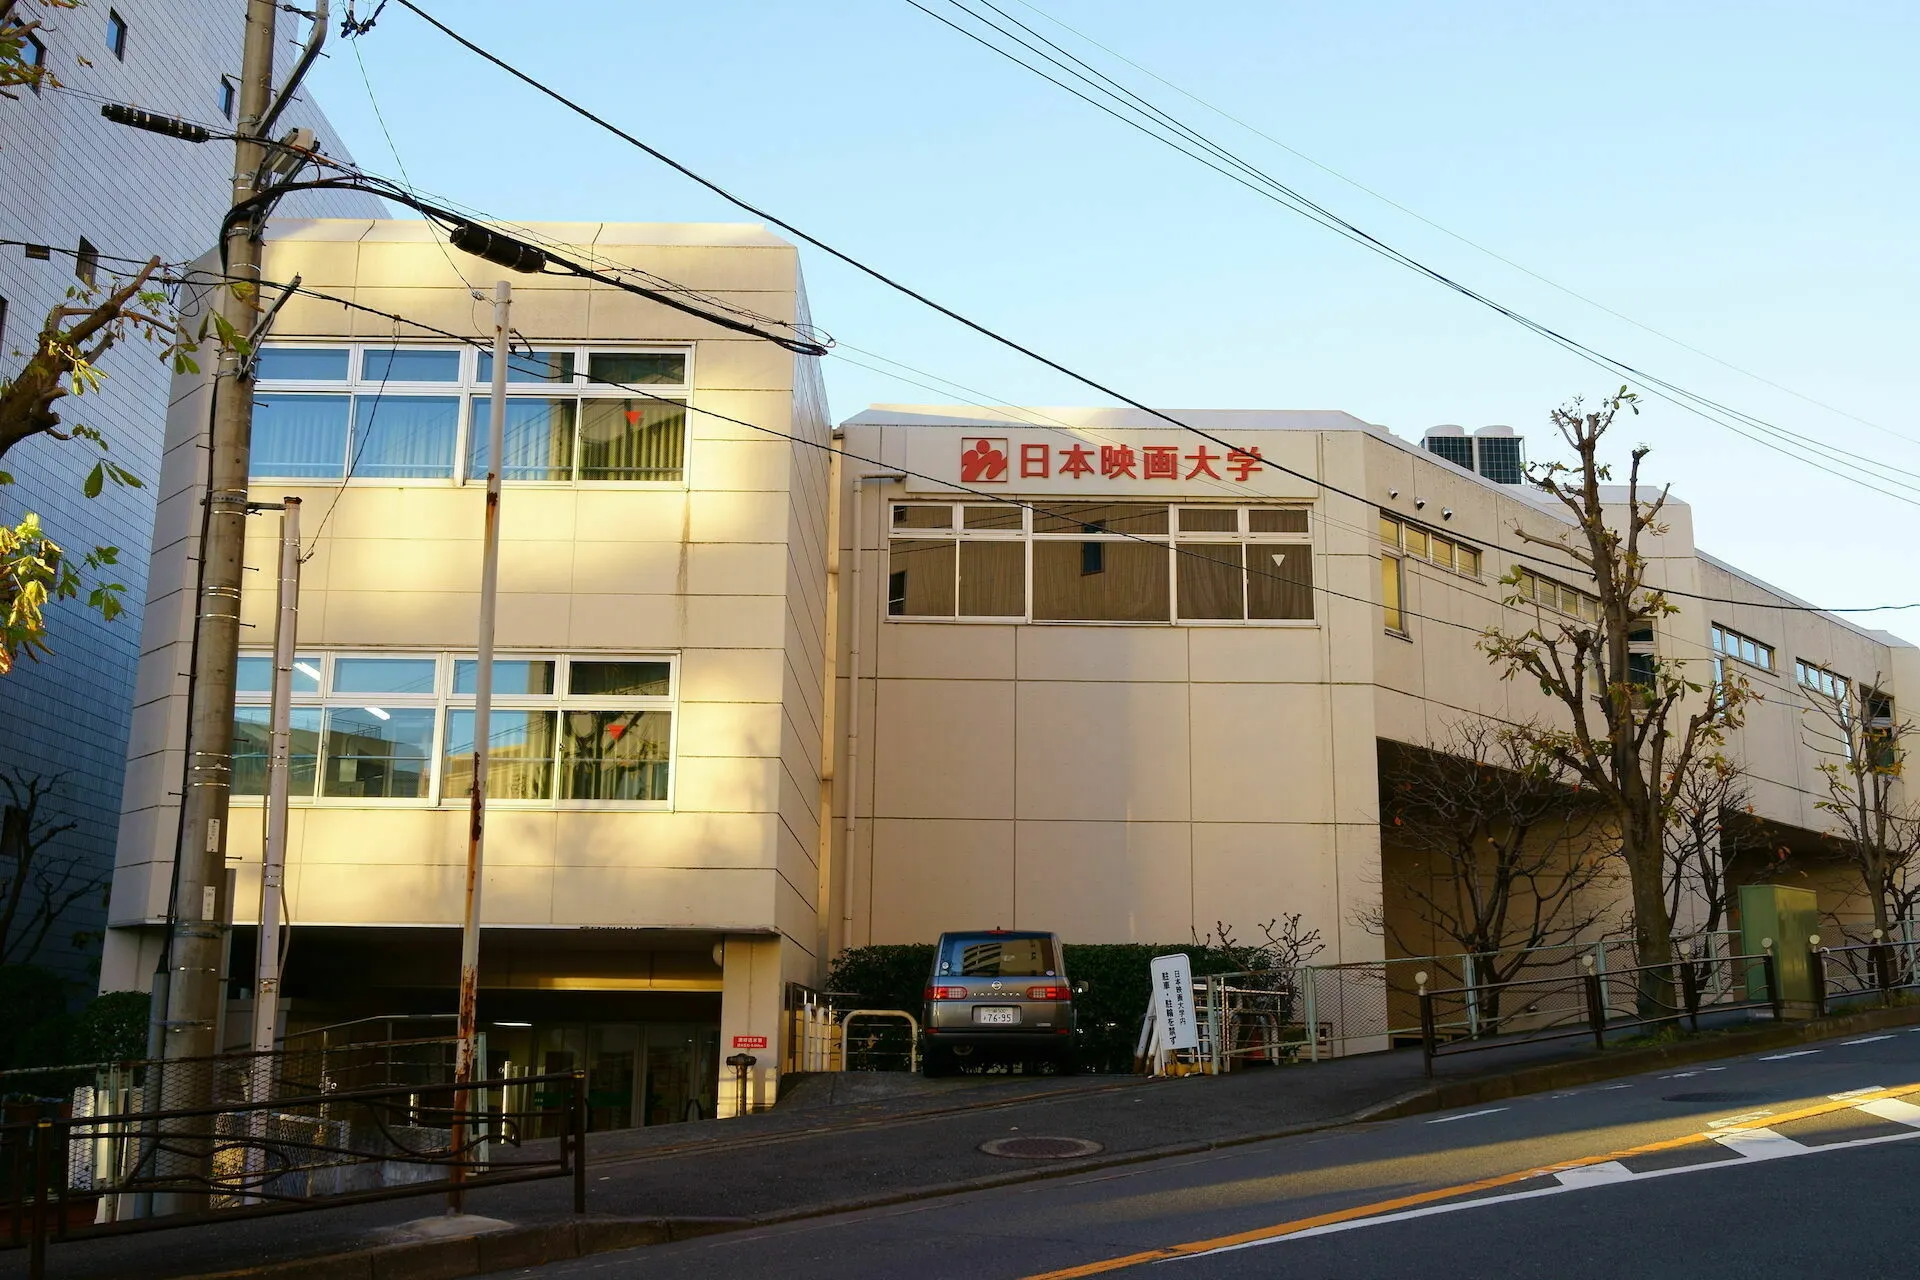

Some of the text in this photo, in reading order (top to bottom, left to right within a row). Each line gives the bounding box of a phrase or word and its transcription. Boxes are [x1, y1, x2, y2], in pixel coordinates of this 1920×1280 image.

[1020, 443, 1263, 482] 日本映画大学
[1174, 970, 1186, 1025] 日本映画大学内
